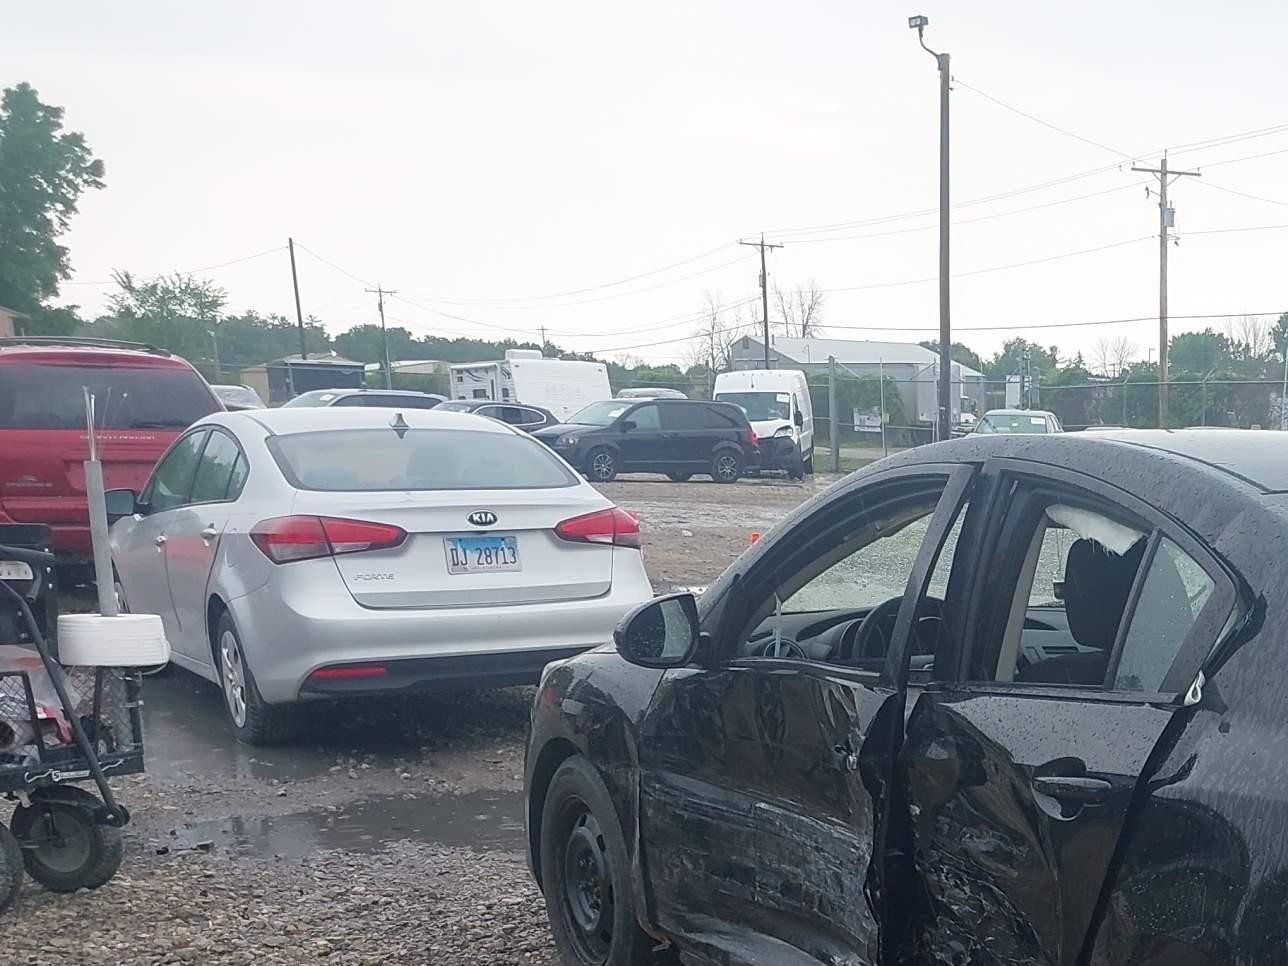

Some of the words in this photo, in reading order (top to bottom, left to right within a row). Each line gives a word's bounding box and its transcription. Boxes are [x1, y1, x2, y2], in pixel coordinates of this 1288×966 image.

[472, 512, 494, 523] KIA
[450, 548, 468, 566] DJ
[475, 546, 517, 566] 28713
